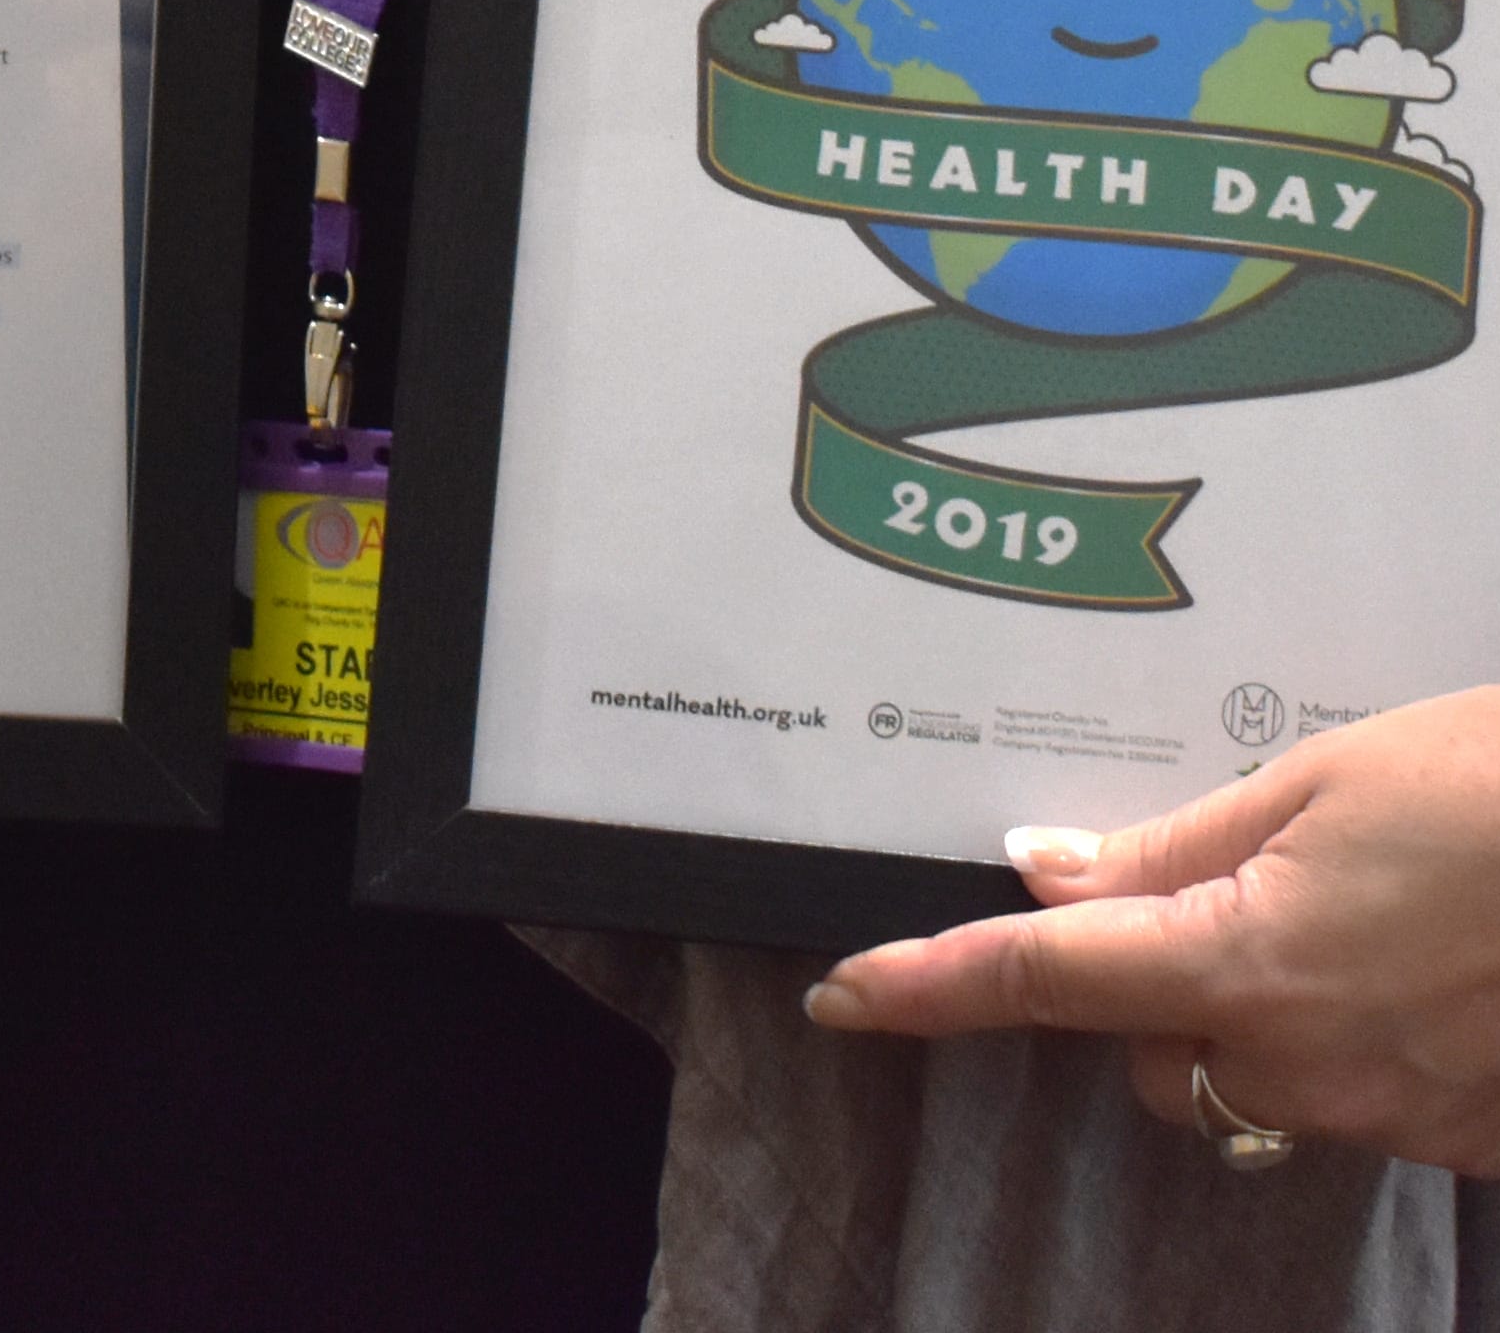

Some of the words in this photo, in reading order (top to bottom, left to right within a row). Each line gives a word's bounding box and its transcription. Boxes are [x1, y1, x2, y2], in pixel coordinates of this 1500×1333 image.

[816, 130, 1149, 206] HEALTH
[1212, 167, 1379, 232] DAY
[883, 483, 1079, 567] 2019
[295, 641, 373, 681] STA
[229, 677, 302, 712] verley
[310, 682, 368, 713] Jess
[590, 686, 829, 731] mentalhealth.org.uk
[908, 729, 981, 744] REGULATOR
